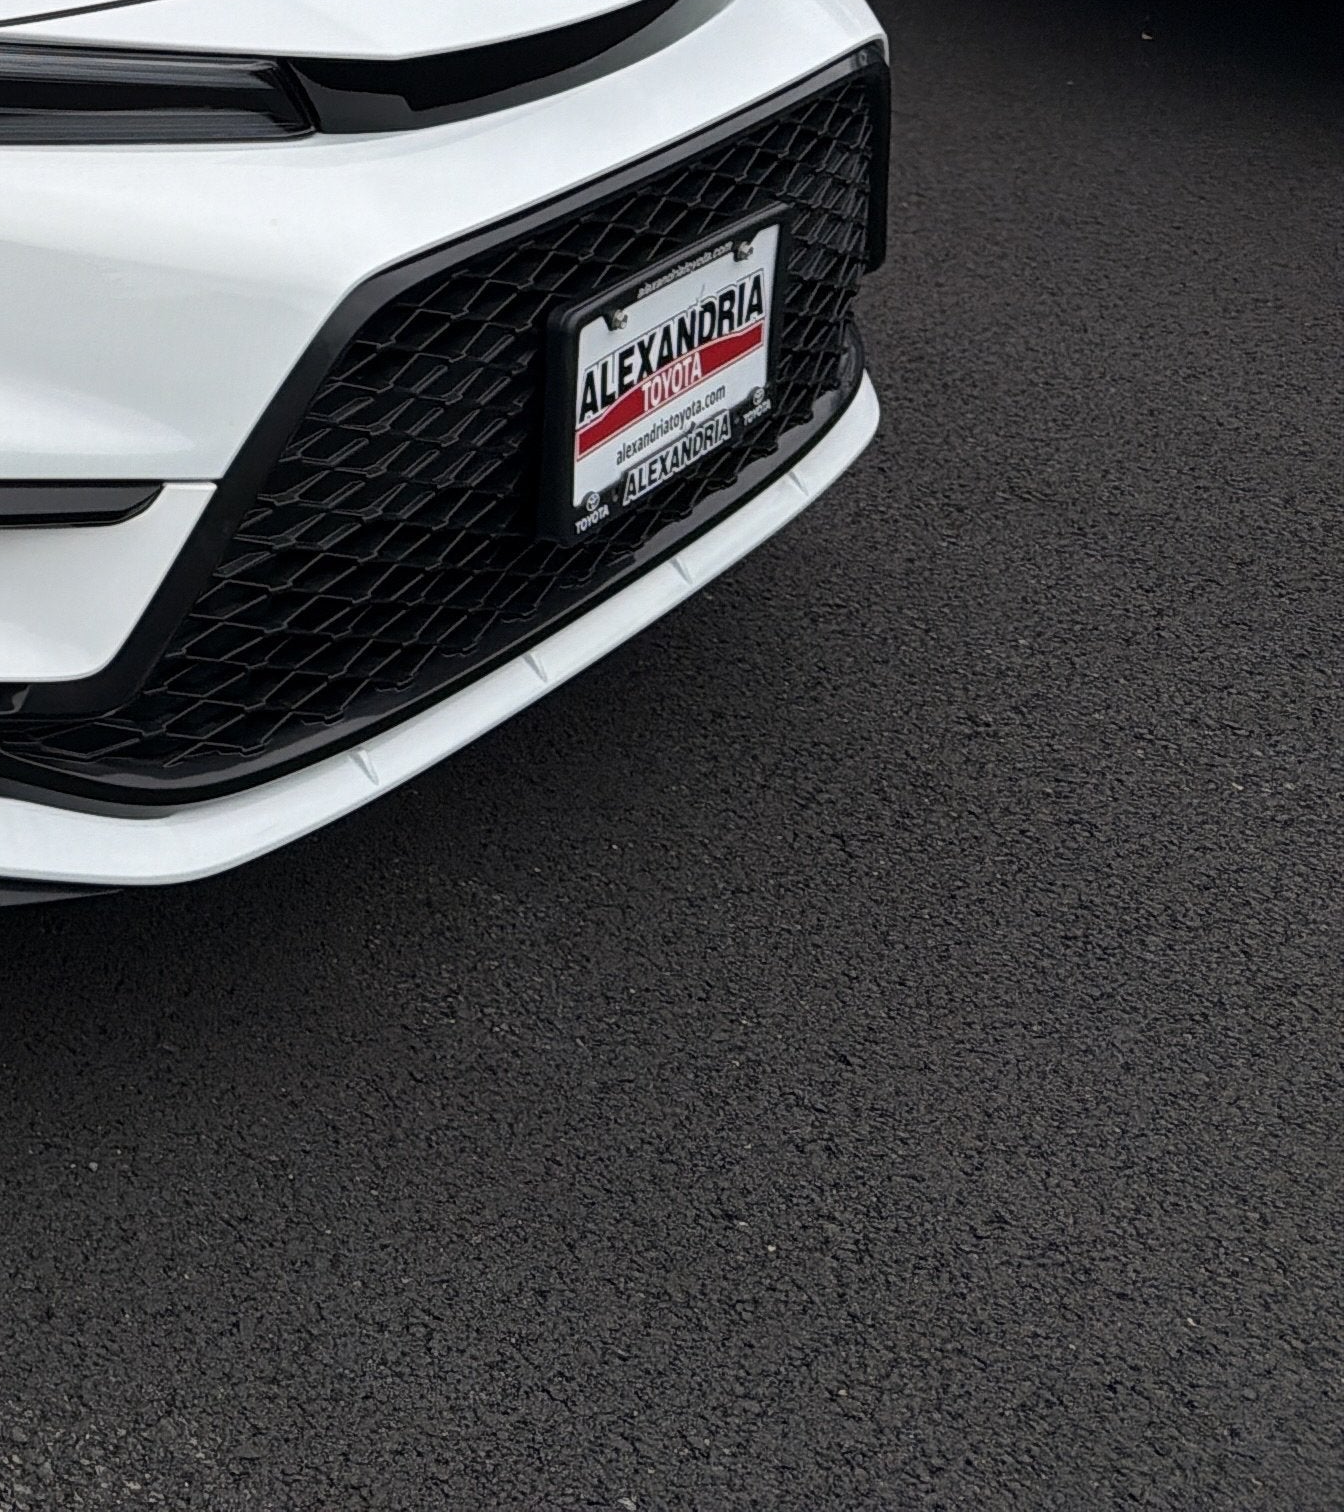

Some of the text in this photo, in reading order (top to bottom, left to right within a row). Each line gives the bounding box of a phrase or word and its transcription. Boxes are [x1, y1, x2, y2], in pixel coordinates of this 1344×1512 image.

[579, 273, 765, 424] ALEXANDRIA
[641, 352, 702, 412] TOYOTA
[616, 385, 726, 465] alexandriatoyota.com
[743, 398, 772, 426] TOYOTA
[623, 411, 731, 505] ALEXANDRIA
[575, 504, 610, 534] TOYOTA
